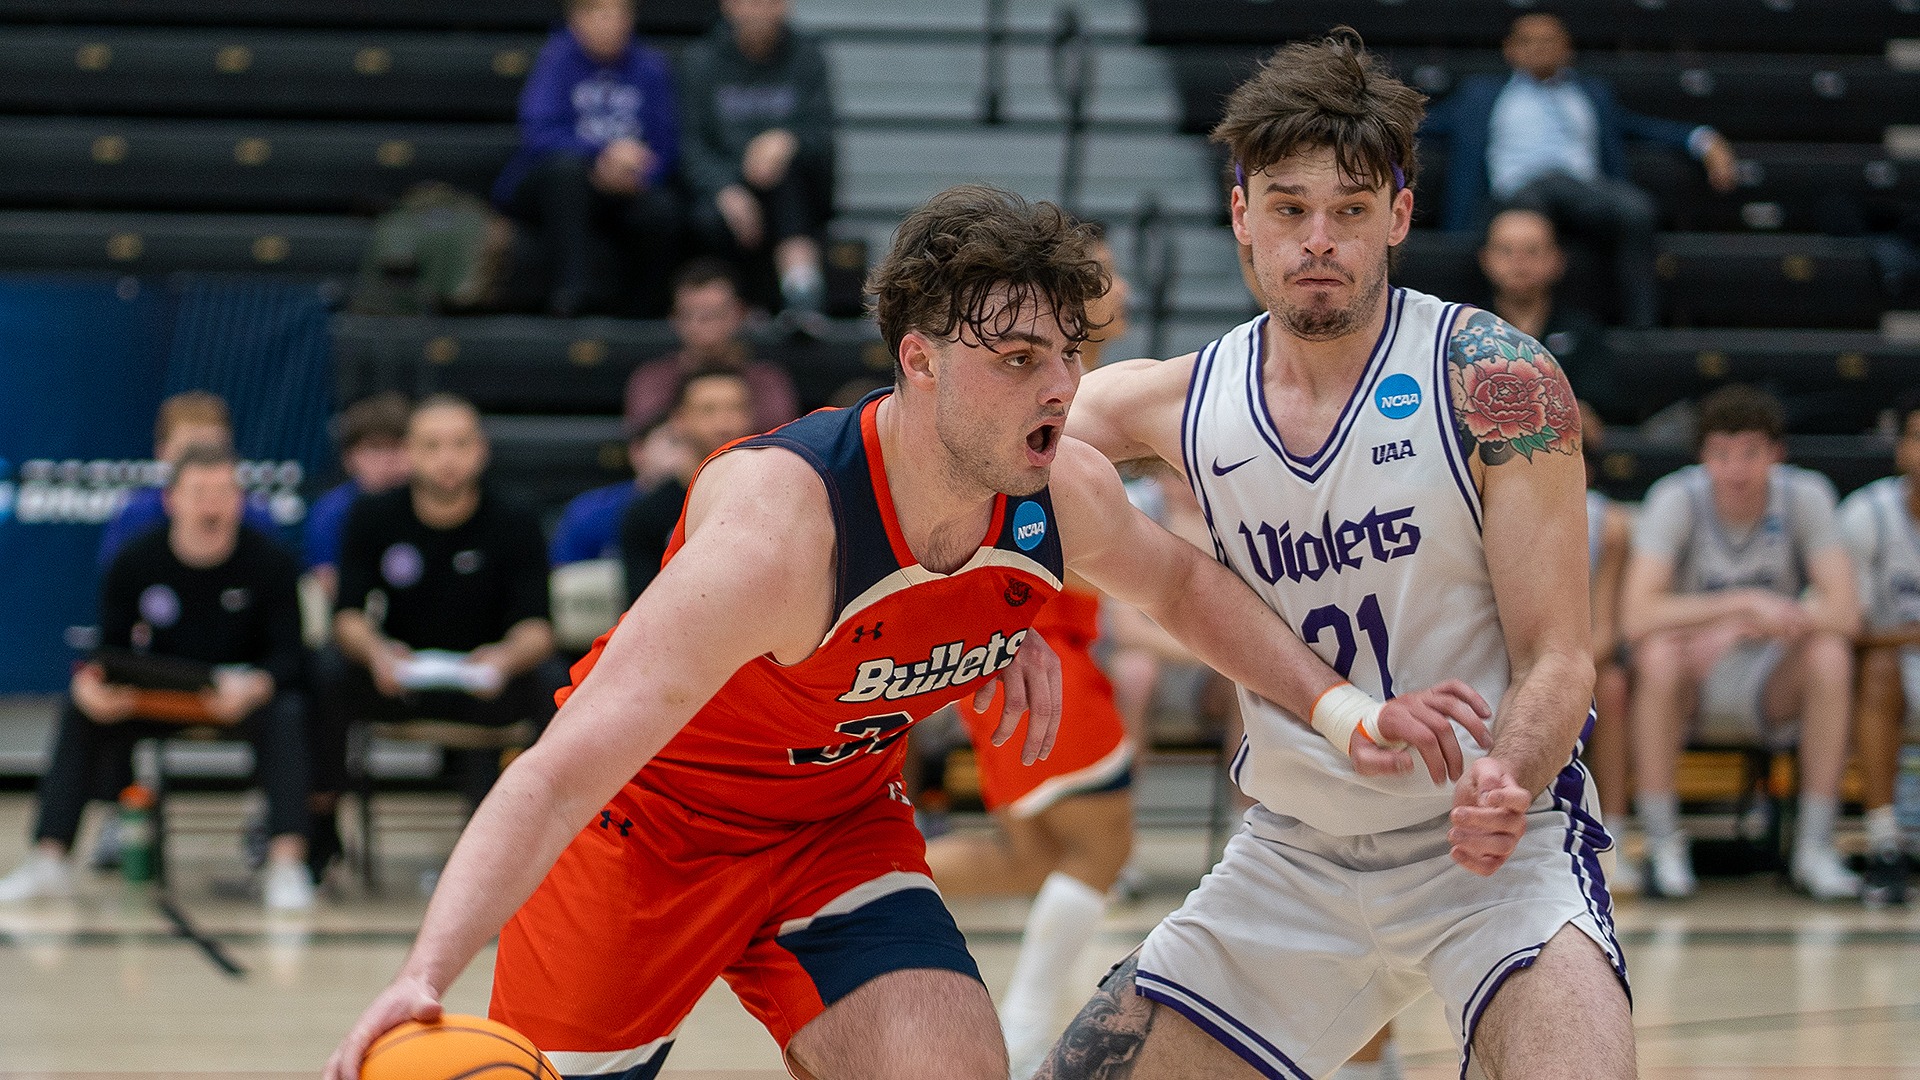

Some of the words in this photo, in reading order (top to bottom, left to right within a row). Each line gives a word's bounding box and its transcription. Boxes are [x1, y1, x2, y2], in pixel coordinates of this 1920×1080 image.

[1381, 393, 1419, 408] NCAA
[1371, 439, 1416, 465] UAA
[1018, 521, 1044, 540] NCAA
[1238, 505, 1421, 586] Violets
[836, 628, 1028, 702] Bullets
[1301, 593, 1396, 701] 21
